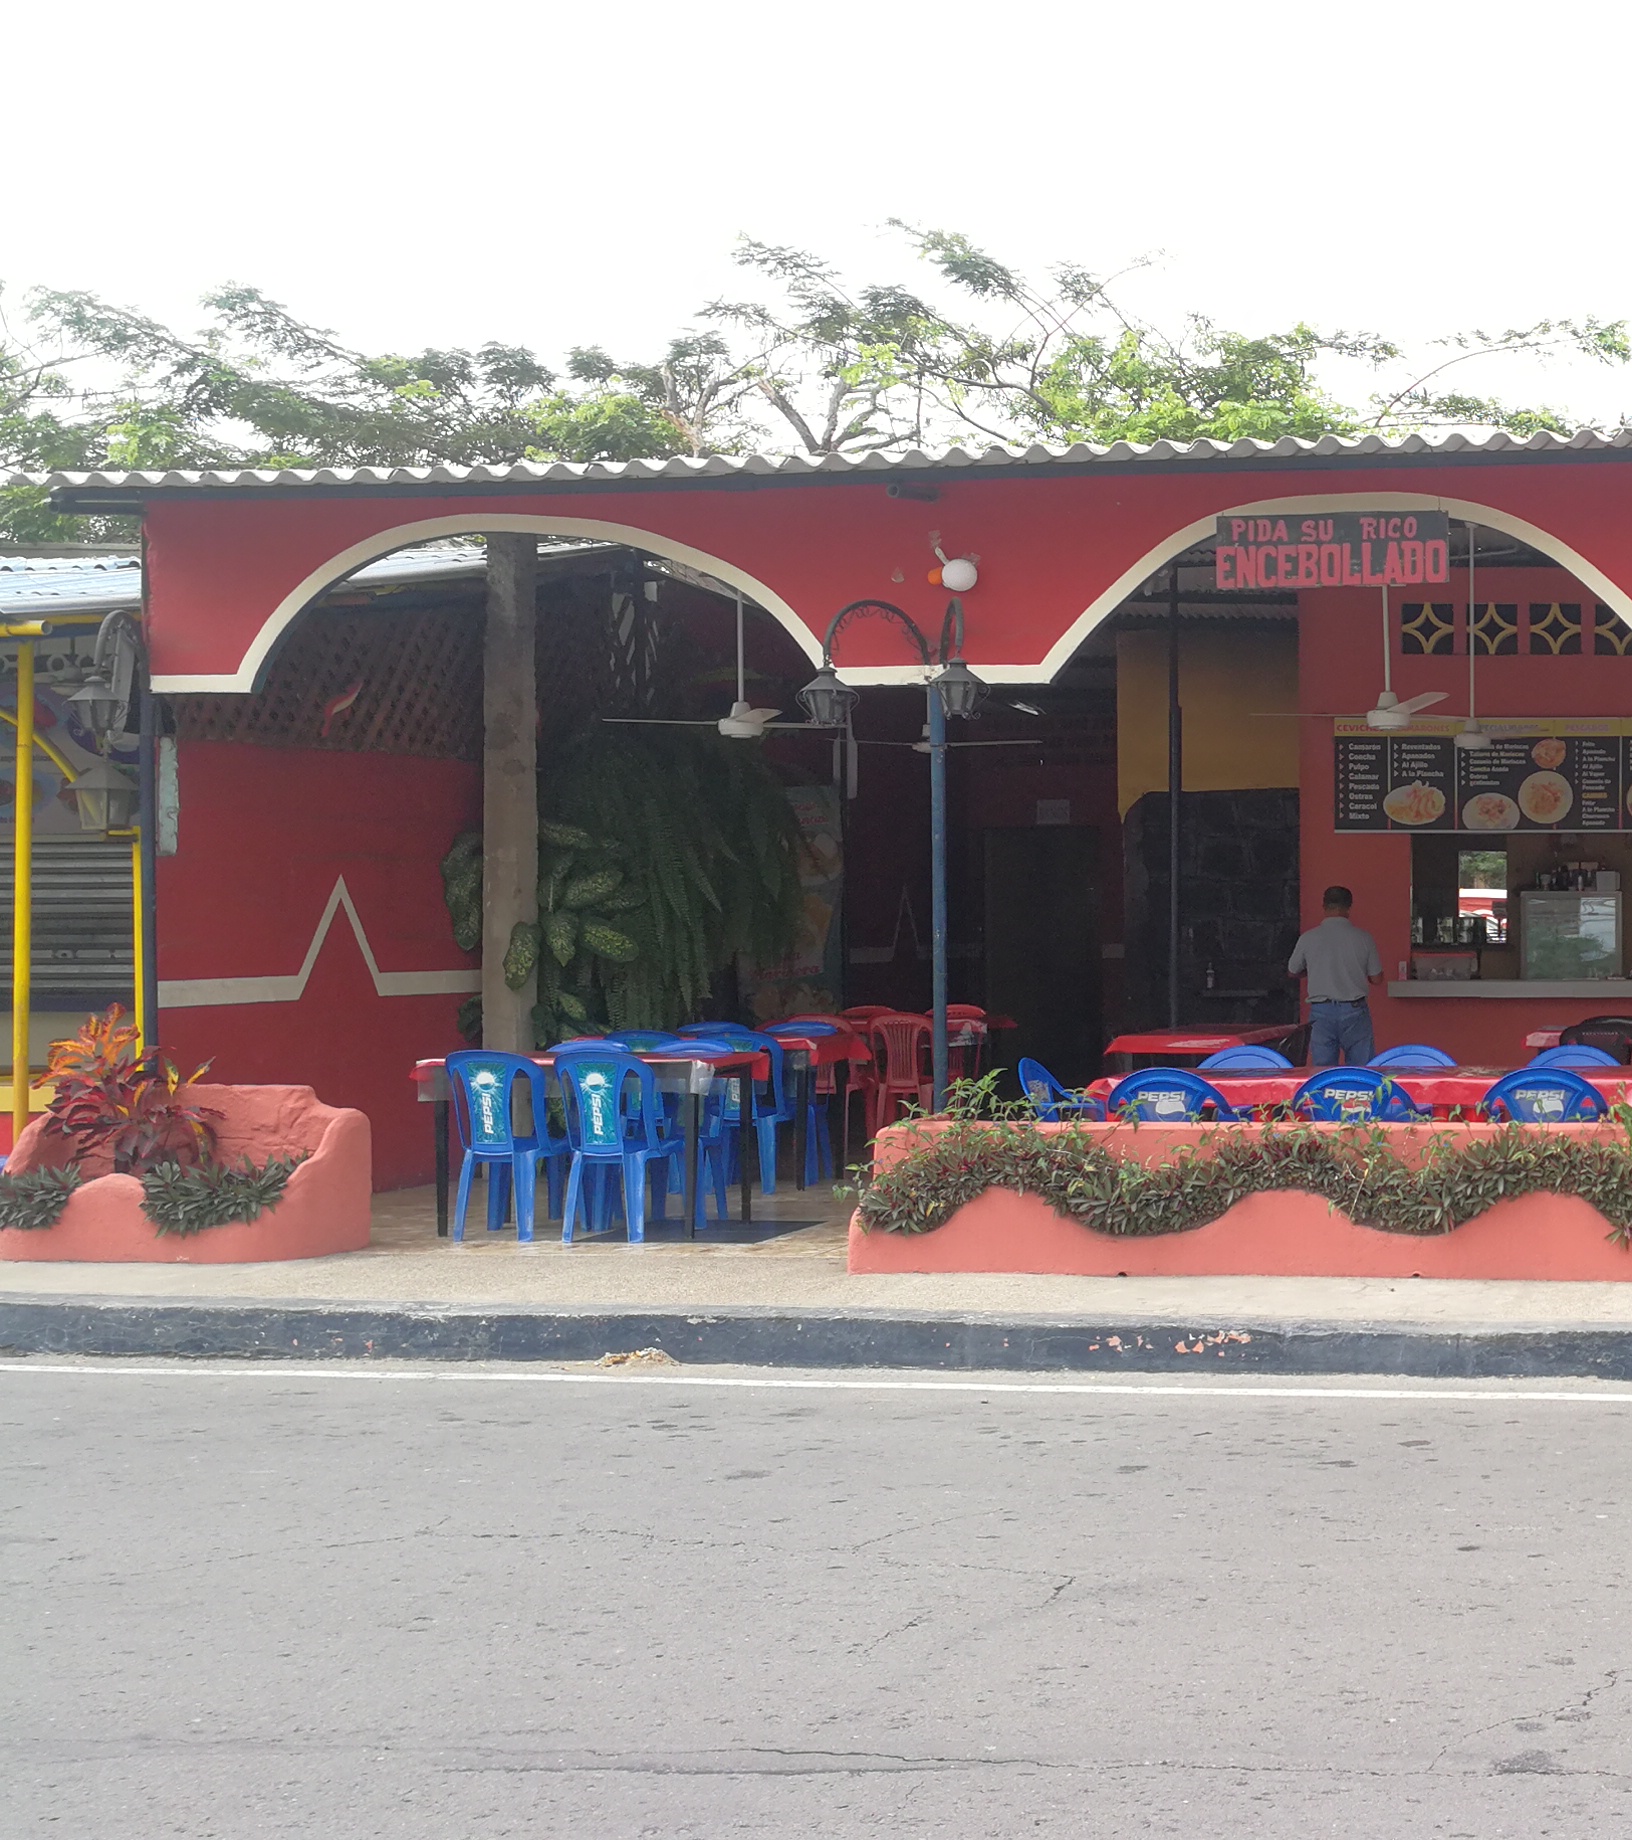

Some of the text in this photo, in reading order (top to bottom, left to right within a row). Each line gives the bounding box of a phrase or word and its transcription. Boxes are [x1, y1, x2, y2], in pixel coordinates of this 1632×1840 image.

[1231, 516, 1418, 543] PIDA SU RICO
[1216, 540, 1448, 588] ENCEBOLLADO
[1349, 763, 1369, 771] Pulpo
[1349, 782, 1380, 790] Pescado
[1349, 802, 1377, 810] Caracol
[1349, 812, 1370, 820] Mixto
[1137, 1090, 1186, 1102] PEPSI
[1324, 1088, 1374, 1100] PEPSI
[1515, 1089, 1565, 1101] PEPSI
[482, 1092, 495, 1135] PEPSI
[591, 1093, 604, 1135] PEPSI
